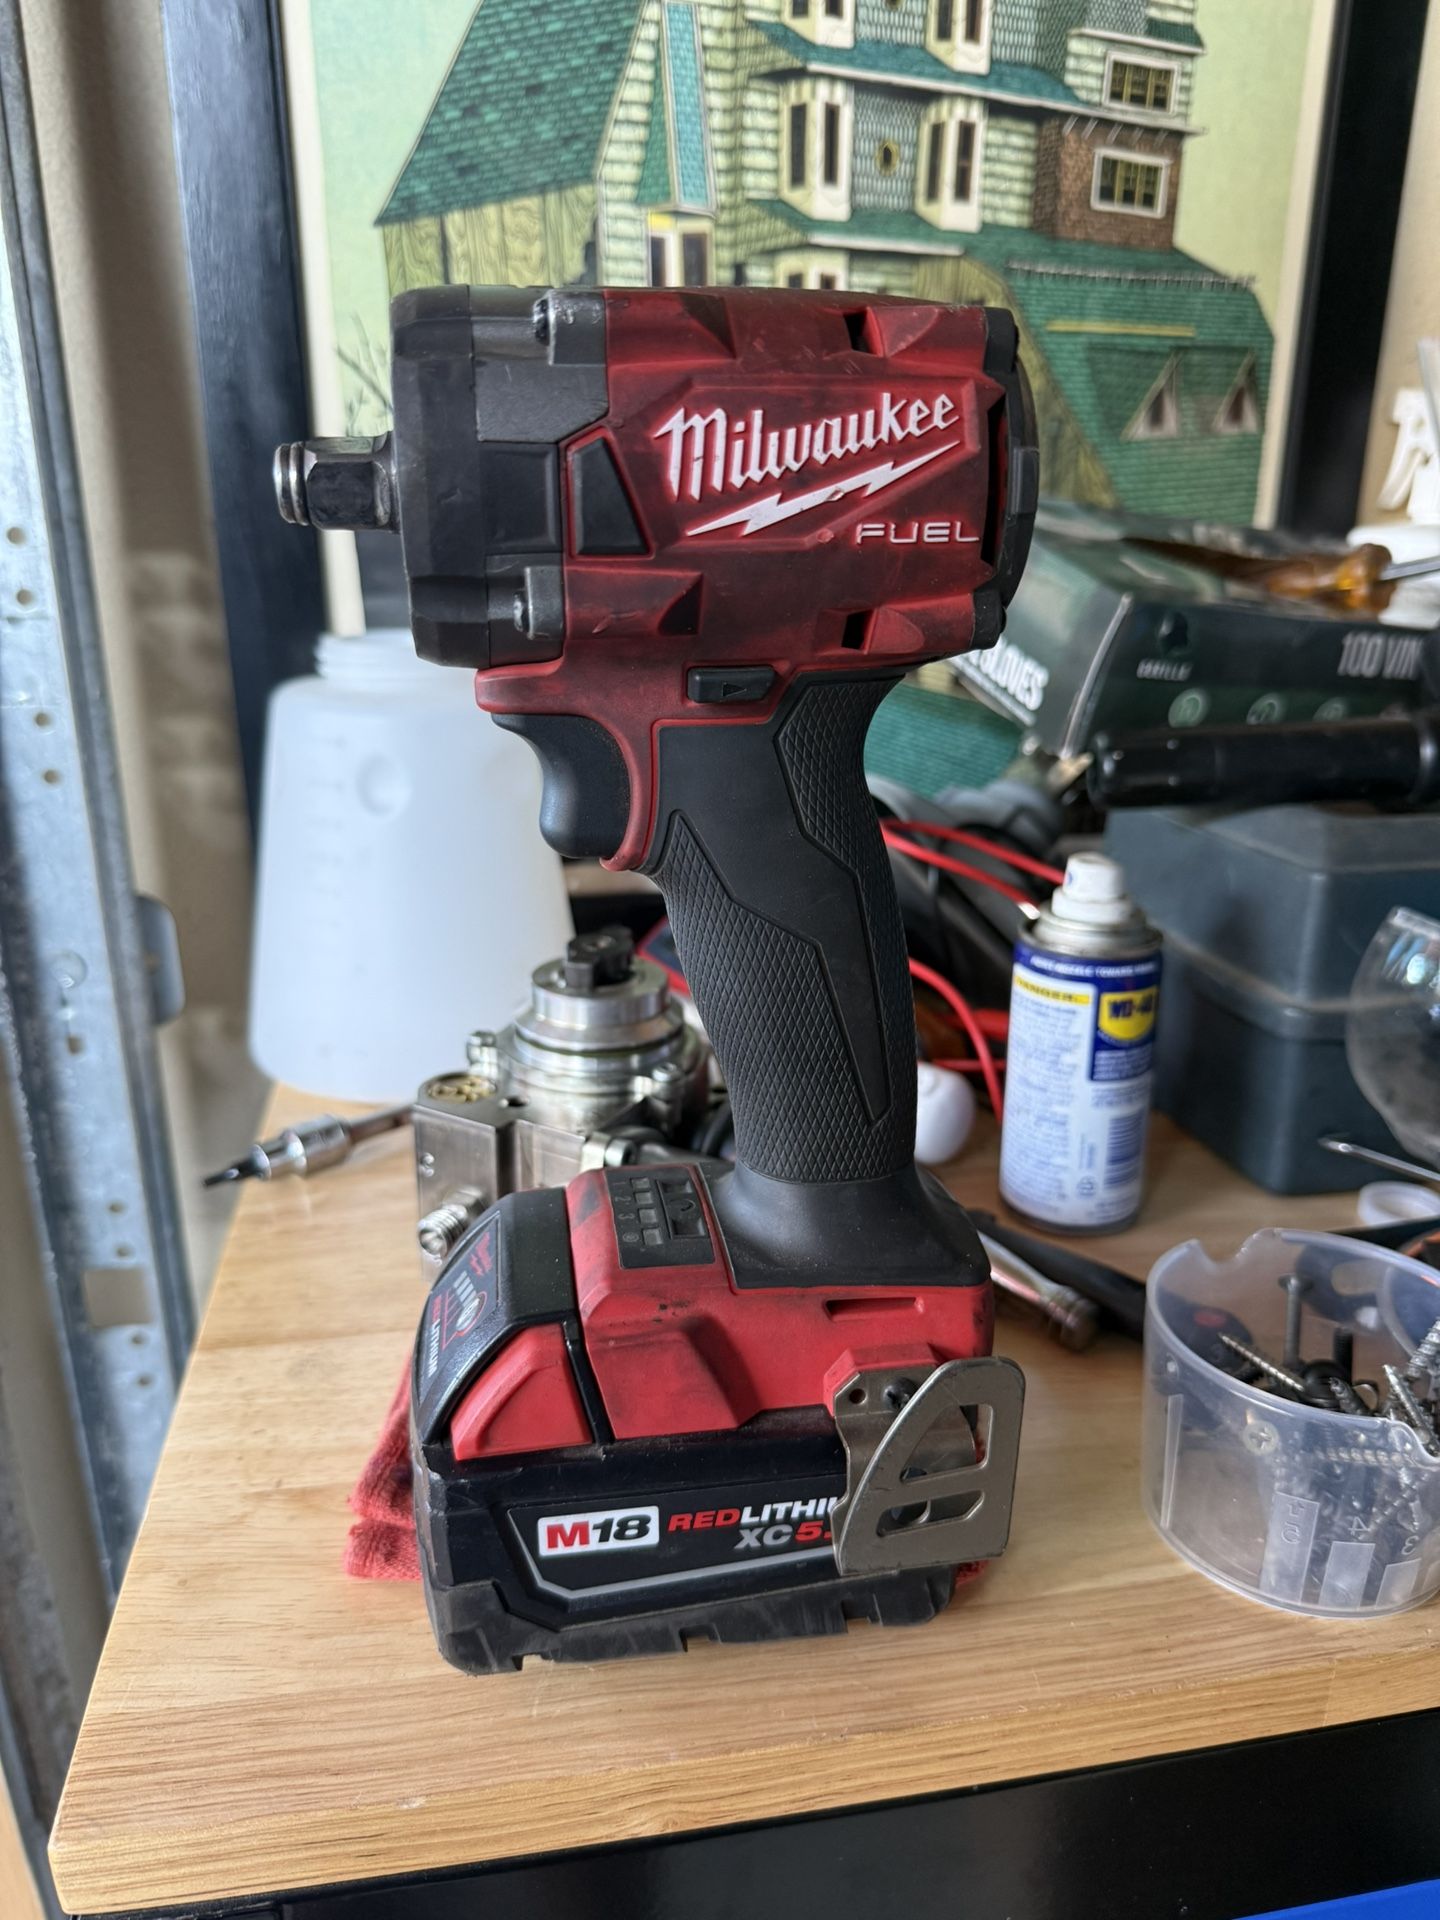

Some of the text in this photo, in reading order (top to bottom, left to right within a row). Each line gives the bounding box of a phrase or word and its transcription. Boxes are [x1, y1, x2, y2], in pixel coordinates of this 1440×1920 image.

[653, 392, 960, 501] Milwaukee
[856, 521, 980, 545] FUEL
[1337, 630, 1385, 678] 100
[546, 1514, 652, 1549] M18
